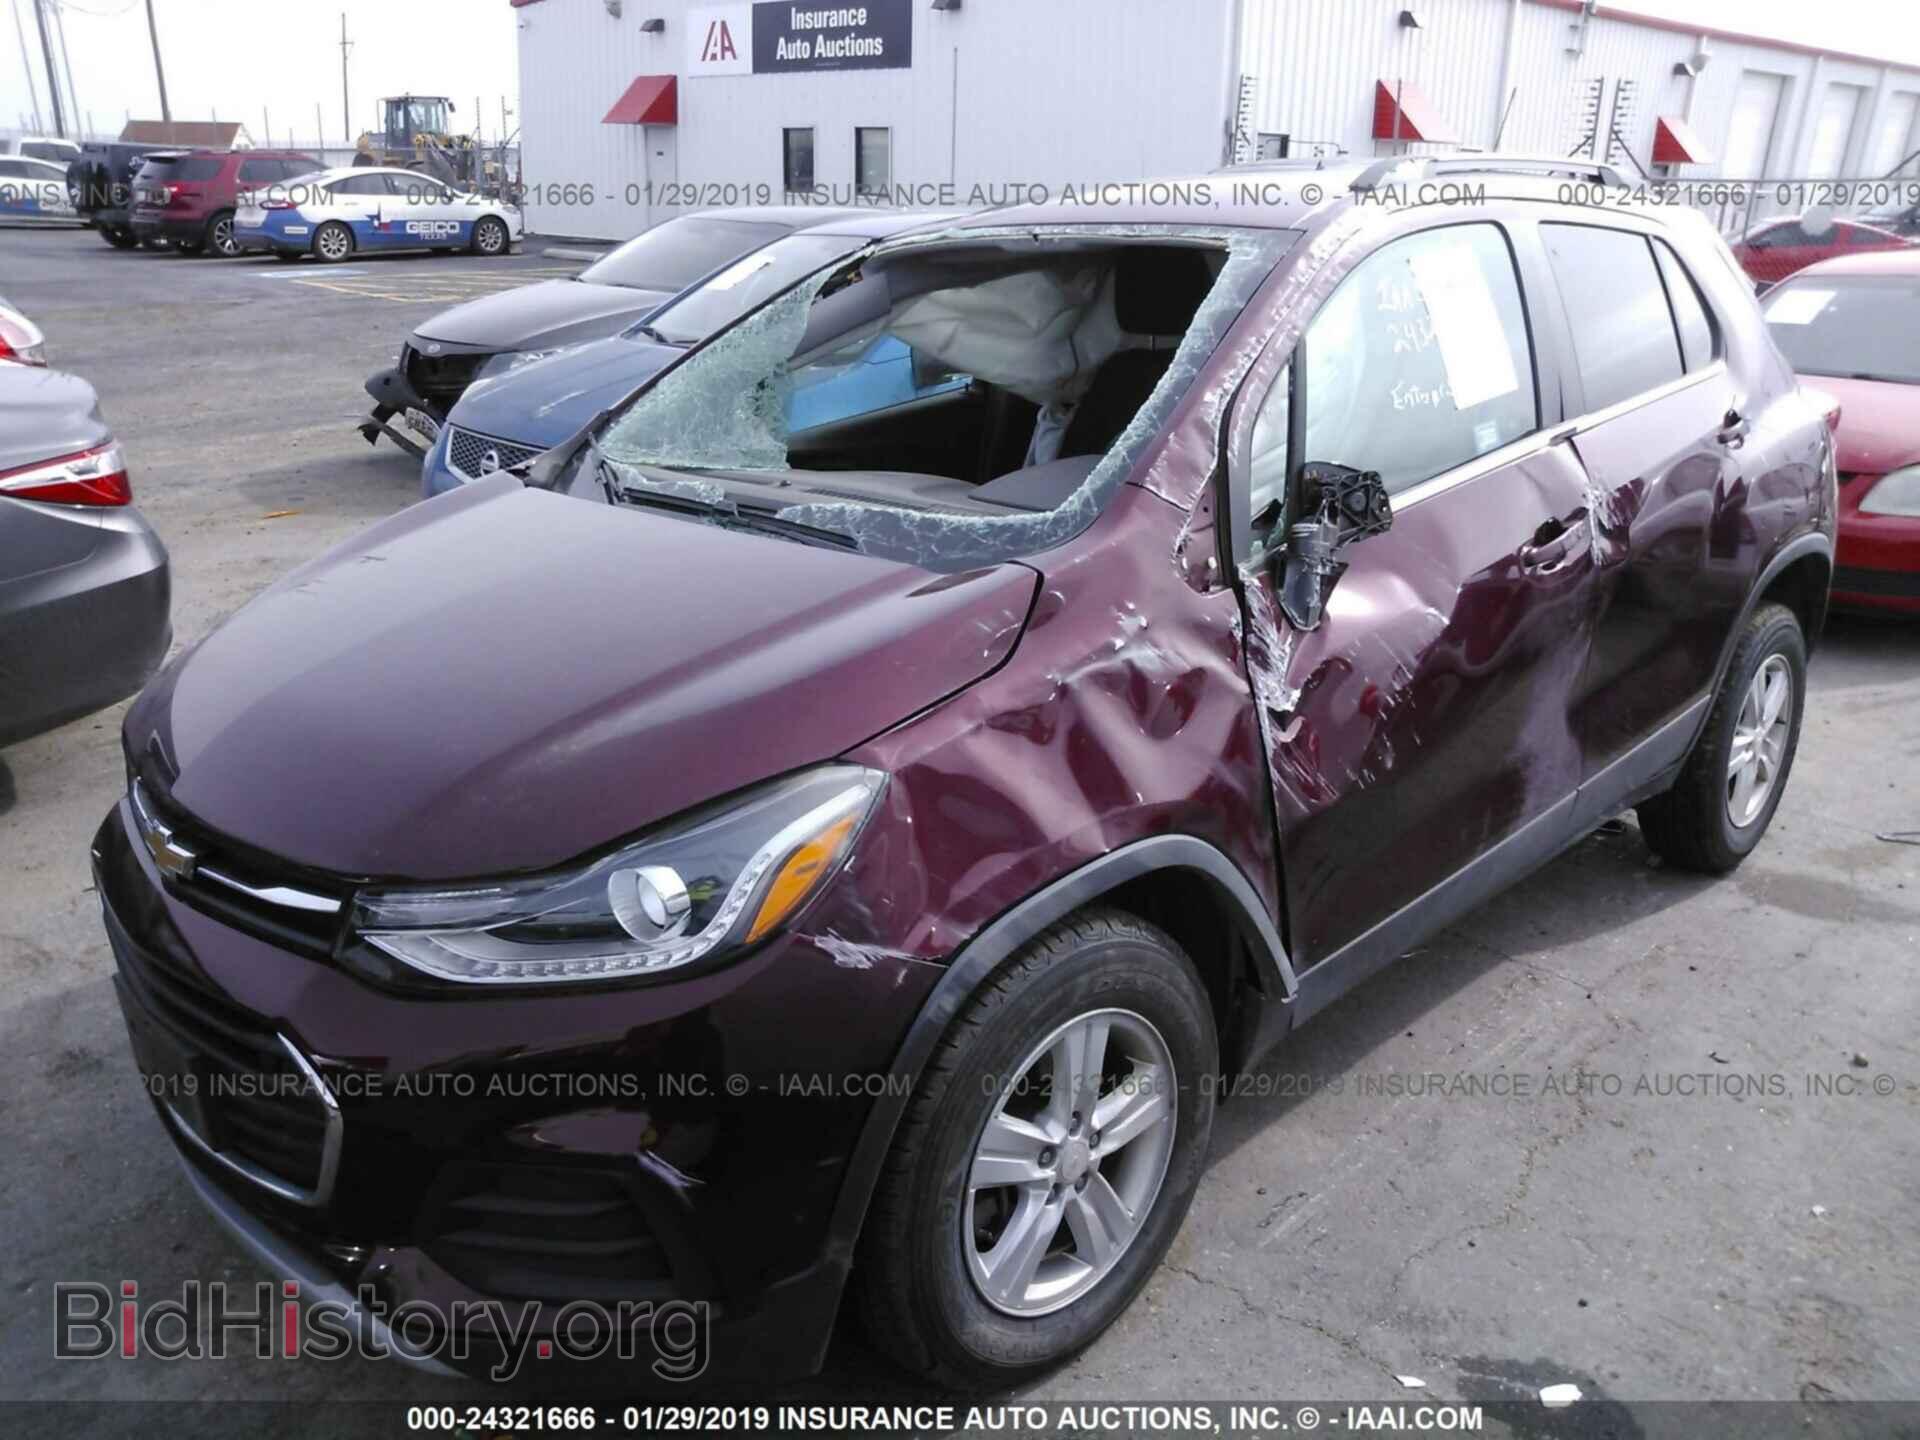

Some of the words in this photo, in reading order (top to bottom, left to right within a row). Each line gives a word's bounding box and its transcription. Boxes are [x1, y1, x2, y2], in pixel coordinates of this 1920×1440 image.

[791, 7, 867, 30] Insurance
[776, 37, 810, 60] Auto
[814, 33, 884, 58] Auctions
[405, 221, 460, 234] GEICO
